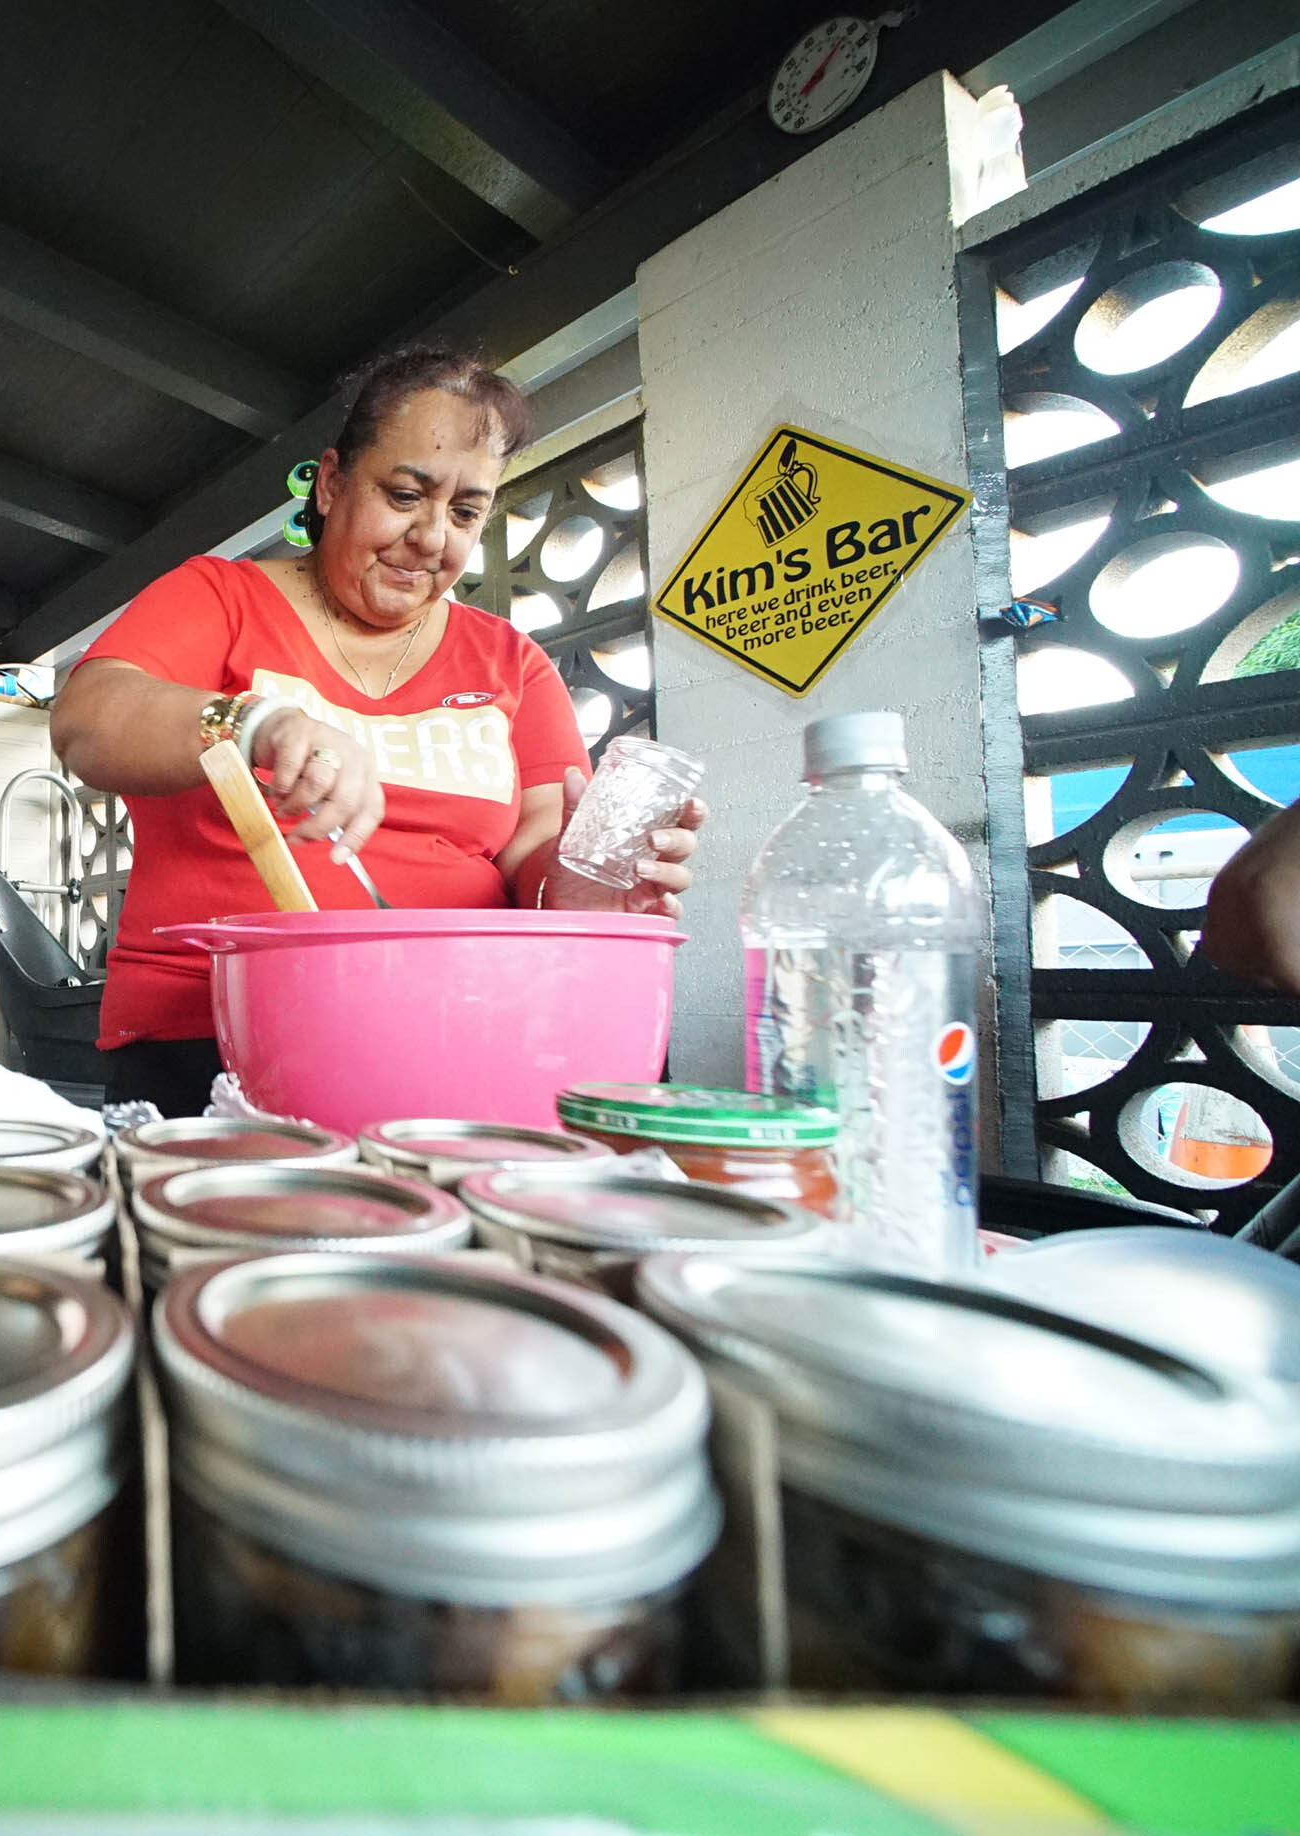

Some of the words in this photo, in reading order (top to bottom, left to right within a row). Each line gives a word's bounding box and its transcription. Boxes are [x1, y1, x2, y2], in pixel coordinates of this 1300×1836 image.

[683, 548, 811, 616] Kim's
[826, 505, 931, 570] Bar
[705, 607, 748, 630] here
[751, 596, 780, 615] we
[783, 577, 836, 606] drink
[726, 616, 771, 640] beer
[774, 602, 812, 626] and
[818, 586, 872, 613] even
[743, 624, 796, 651] more
[801, 610, 854, 636] beer.
